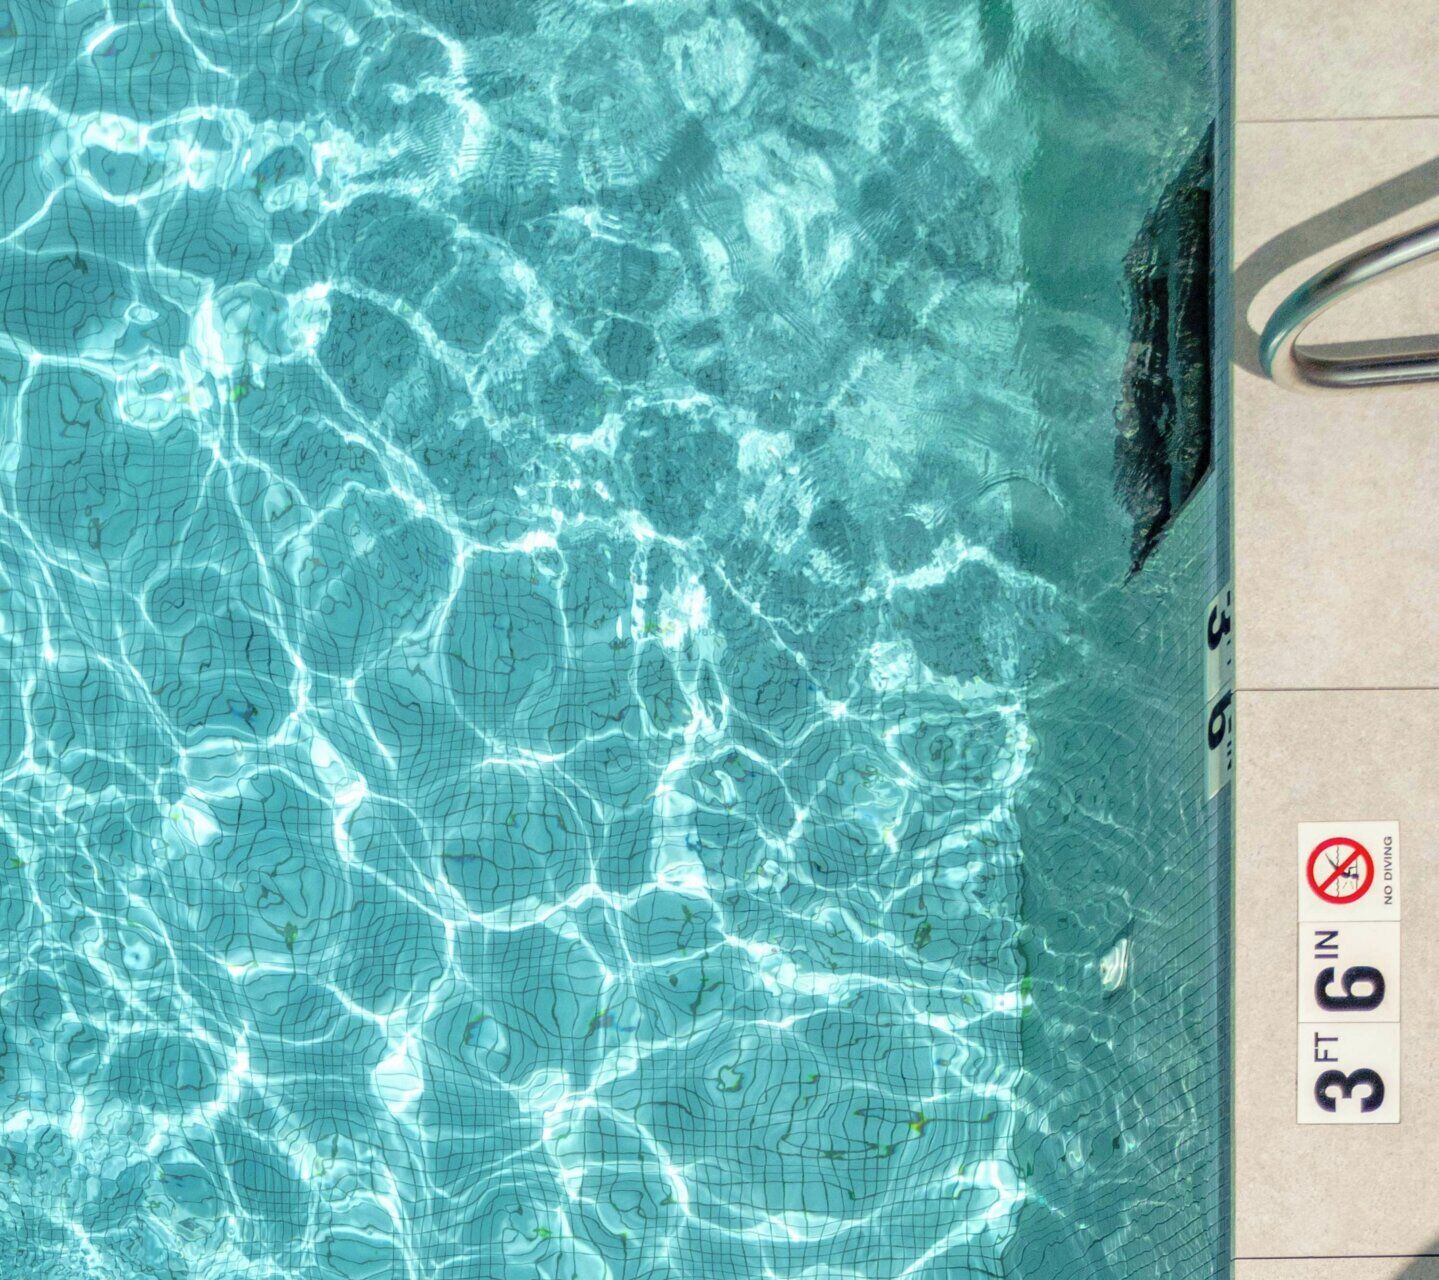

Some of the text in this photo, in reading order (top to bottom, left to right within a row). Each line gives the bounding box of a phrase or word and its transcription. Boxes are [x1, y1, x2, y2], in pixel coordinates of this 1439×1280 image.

[1383, 836, 1393, 905] NO DIVING
[1314, 930, 1385, 1113] 3 FT 6 IN
